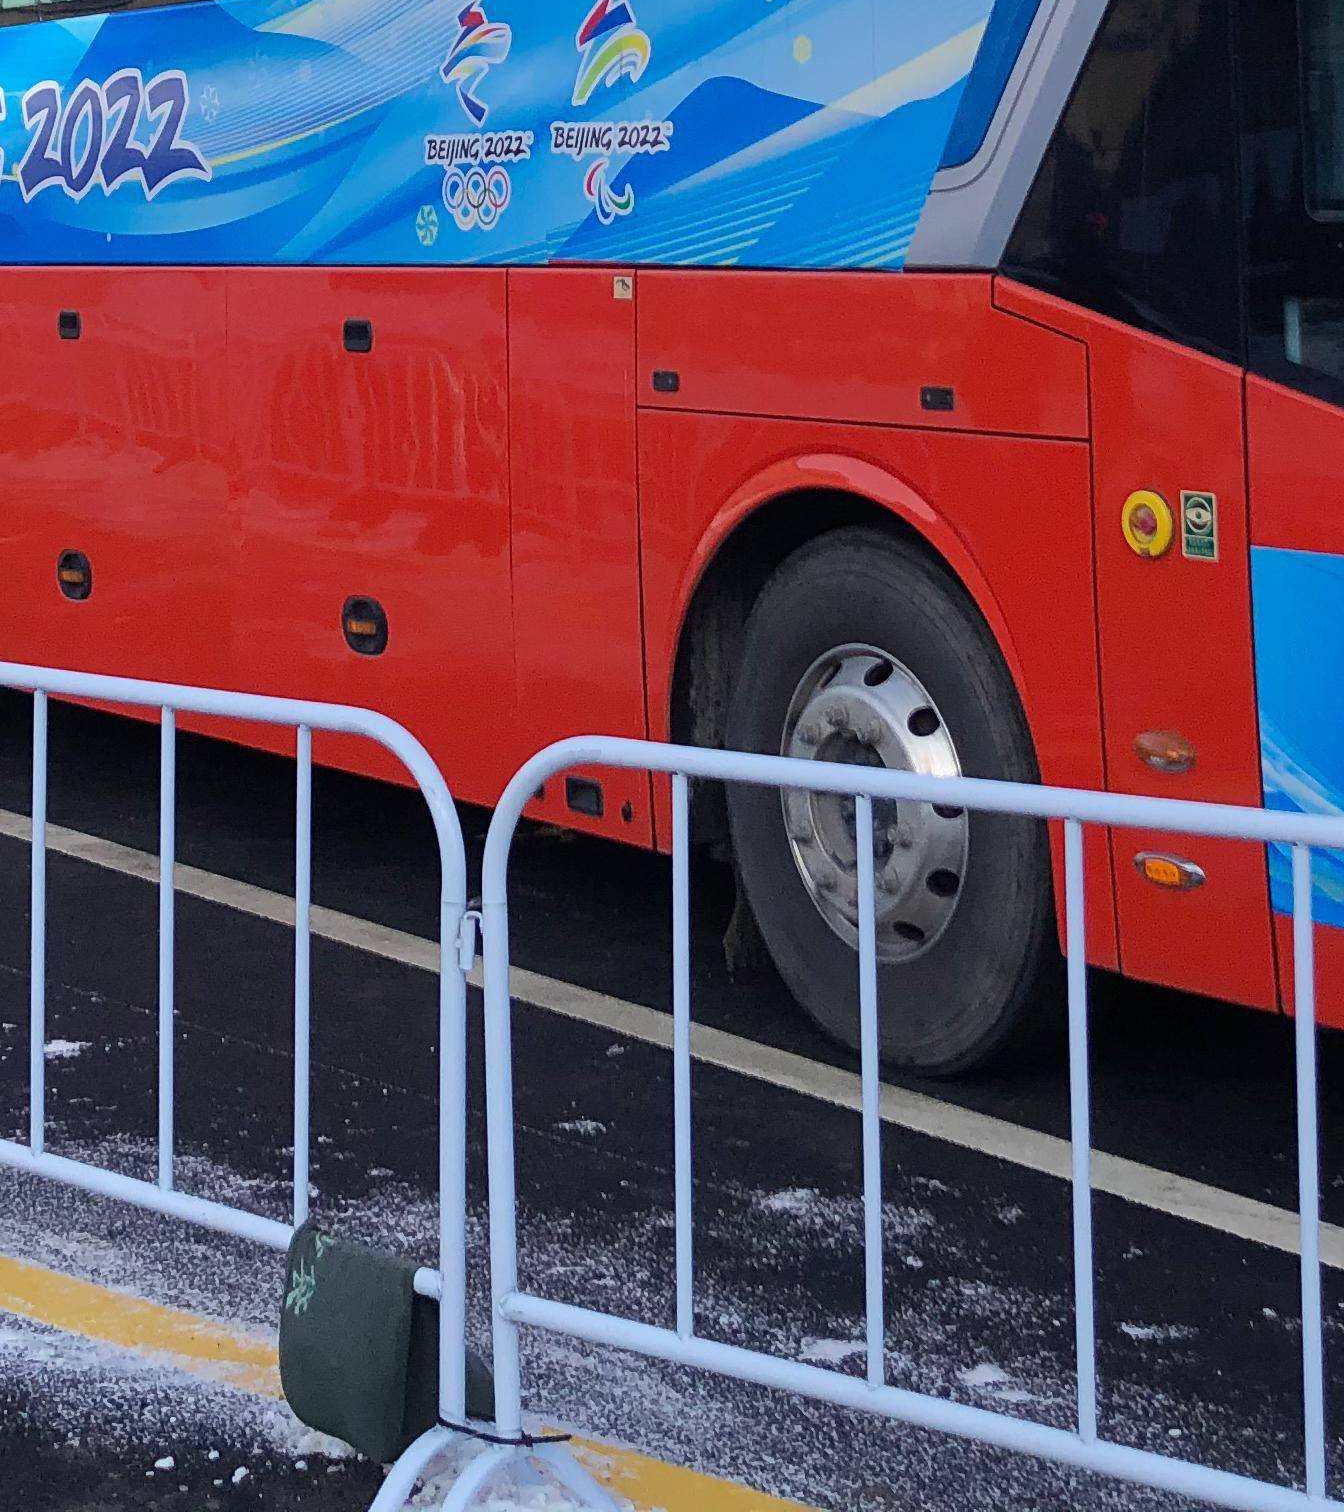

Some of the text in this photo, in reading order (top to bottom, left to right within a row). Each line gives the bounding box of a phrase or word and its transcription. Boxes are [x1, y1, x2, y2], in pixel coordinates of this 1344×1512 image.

[21, 68, 212, 202] 2022
[553, 124, 668, 155] BEIJING 2022
[427, 136, 527, 167] BEIJING 2022
